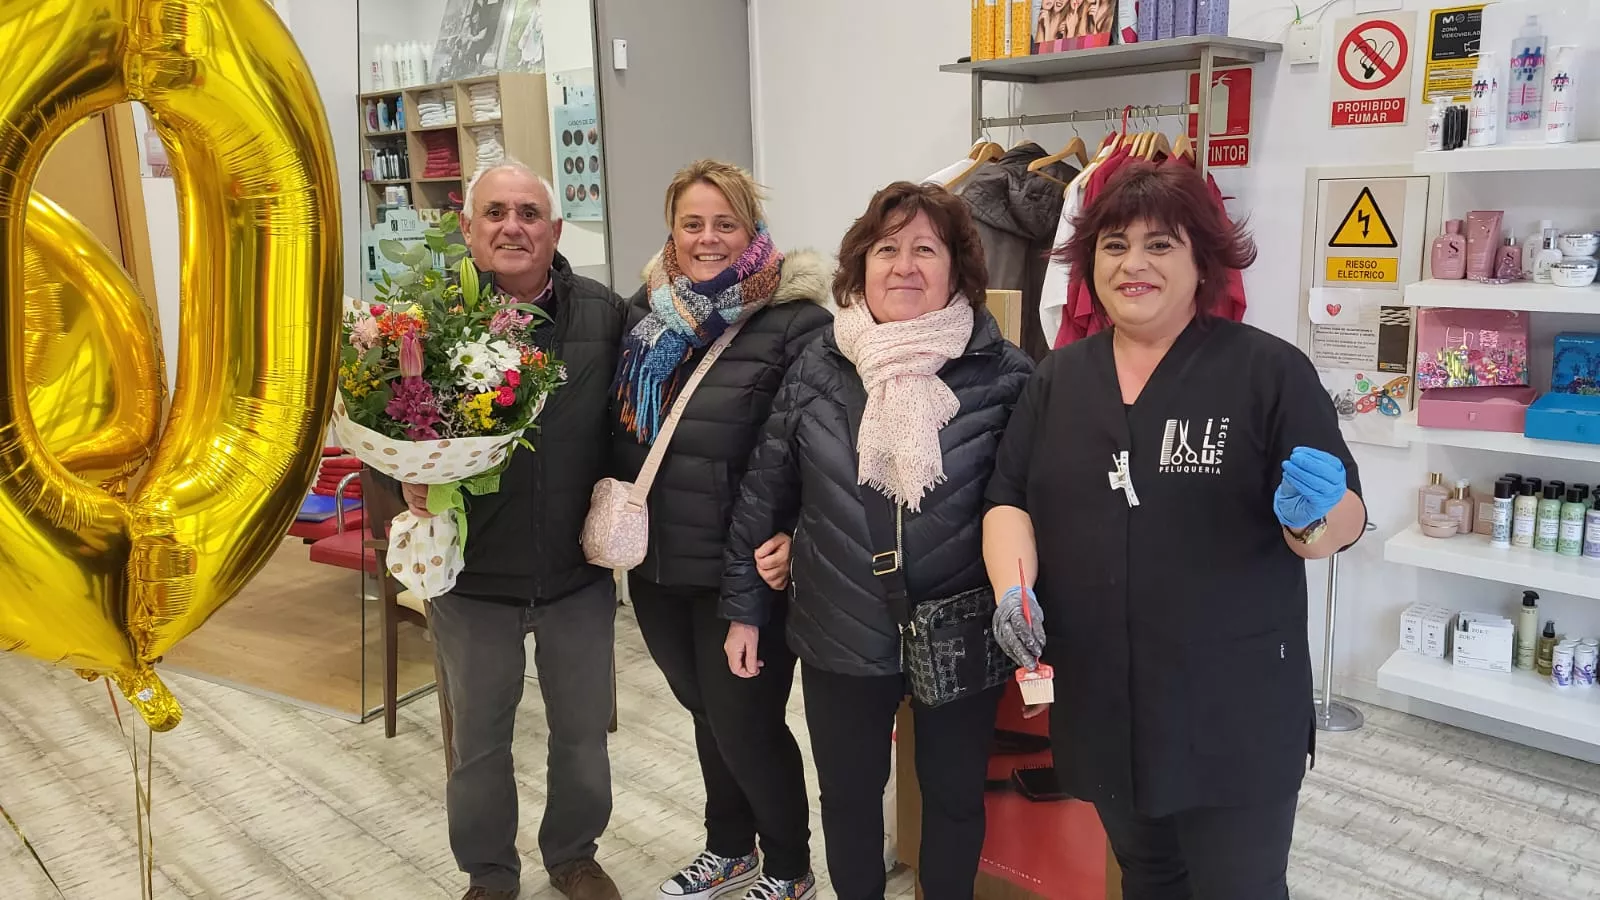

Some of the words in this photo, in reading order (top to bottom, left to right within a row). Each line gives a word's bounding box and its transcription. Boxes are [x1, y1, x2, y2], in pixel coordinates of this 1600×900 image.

[1441, 31, 1481, 39] VIDEOVIGILAD
[1337, 99, 1401, 113] PROHIBIDO
[1347, 112, 1388, 124] FUMAR
[1208, 144, 1247, 162] INTOR
[1345, 259, 1378, 270] RIESGO
[1337, 269, 1385, 281] ELECTRICO
[1214, 416, 1230, 465] SEGURA
[1158, 465, 1221, 475] PELUQUERIA
